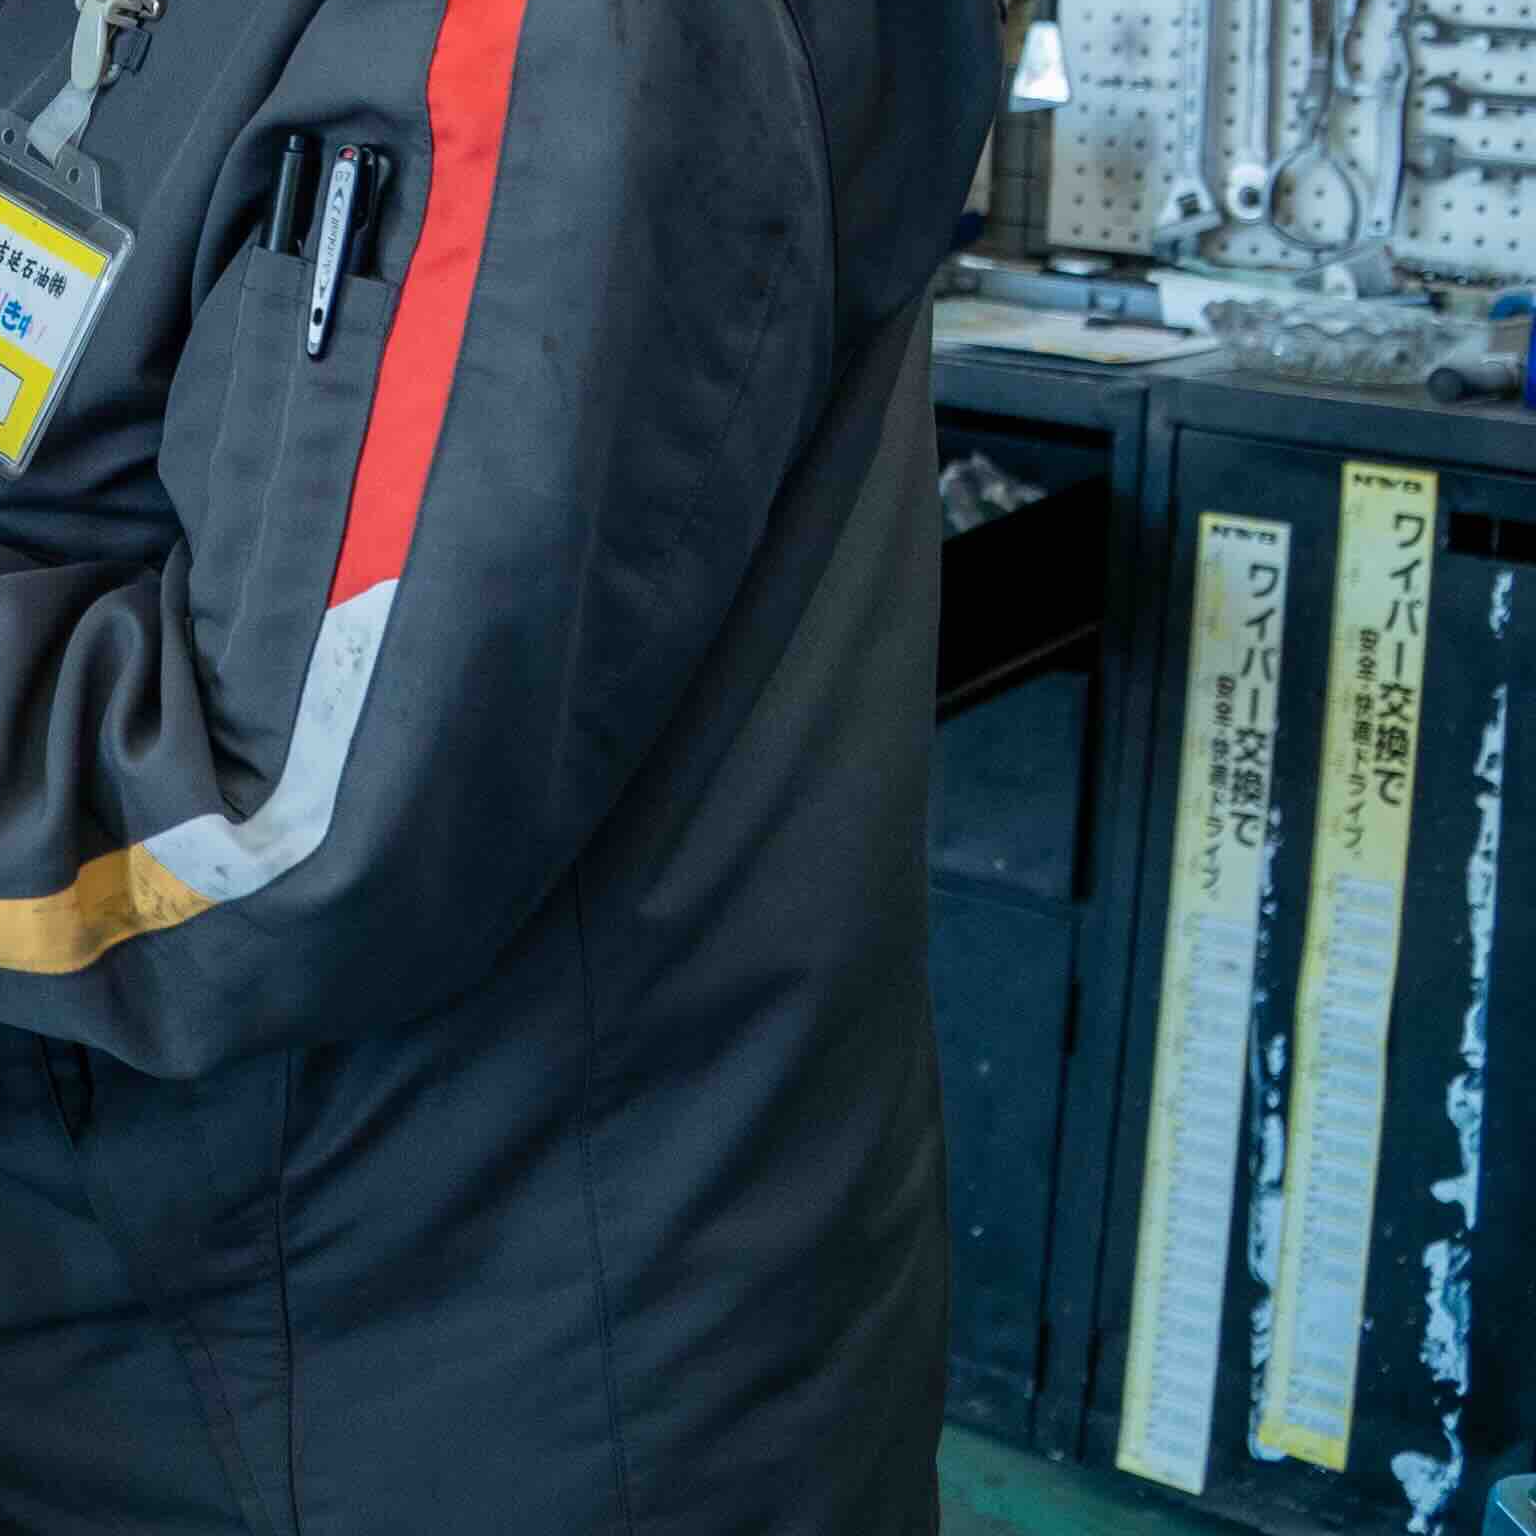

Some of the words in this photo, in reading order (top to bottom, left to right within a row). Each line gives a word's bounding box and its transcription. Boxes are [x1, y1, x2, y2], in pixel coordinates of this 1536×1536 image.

[1227, 563, 1282, 848] ワイパー交換で
[1371, 511, 1425, 806] ワイパー交換で
